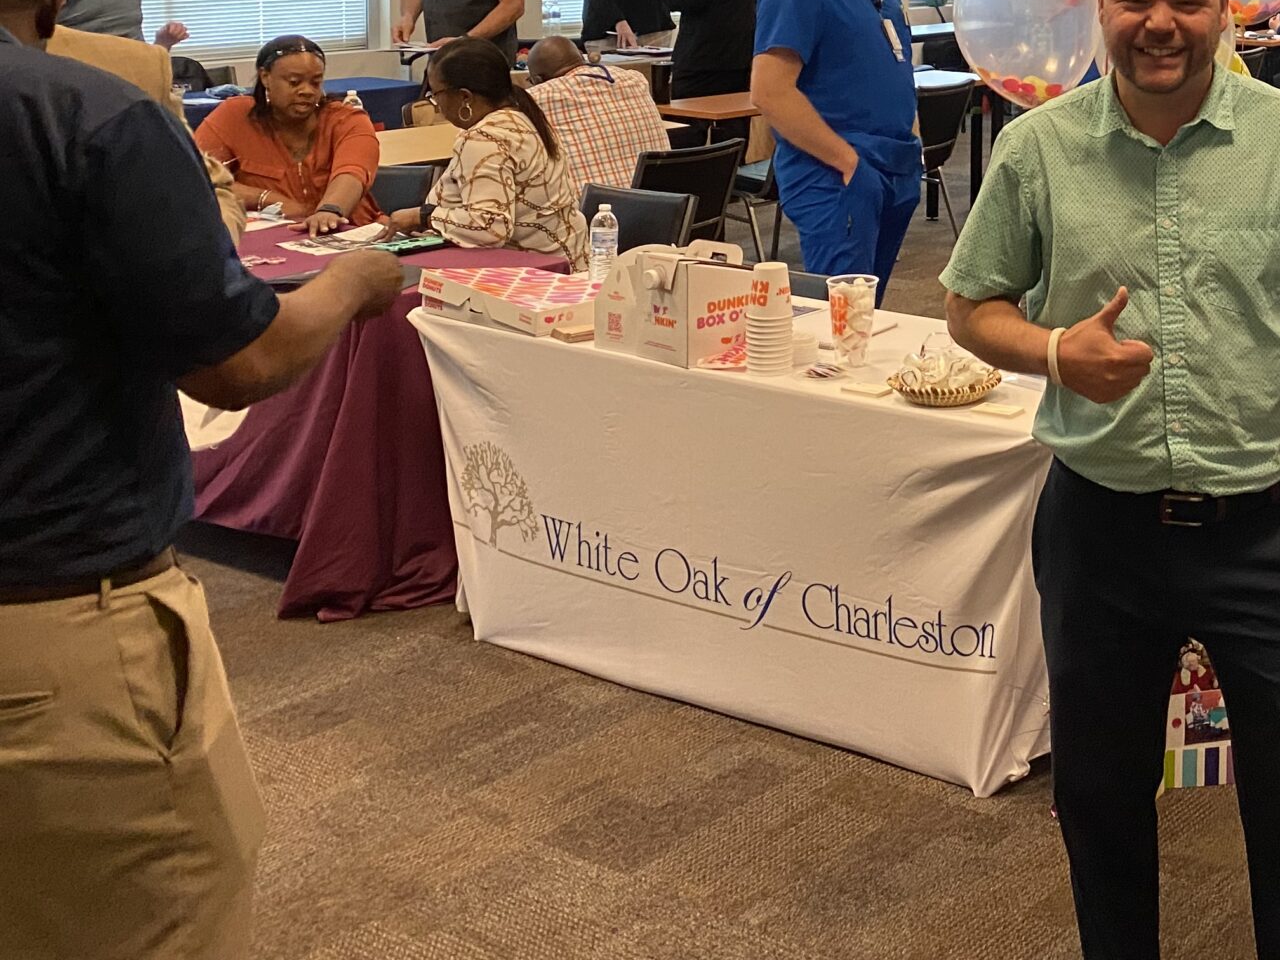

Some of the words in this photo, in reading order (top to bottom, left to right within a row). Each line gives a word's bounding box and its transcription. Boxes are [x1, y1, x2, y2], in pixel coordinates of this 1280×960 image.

[696, 313, 726, 330] BOX
[540, 514, 640, 581] White
[655, 548, 732, 607] Oak
[739, 571, 793, 630] of
[802, 583, 996, 659] Charleston
